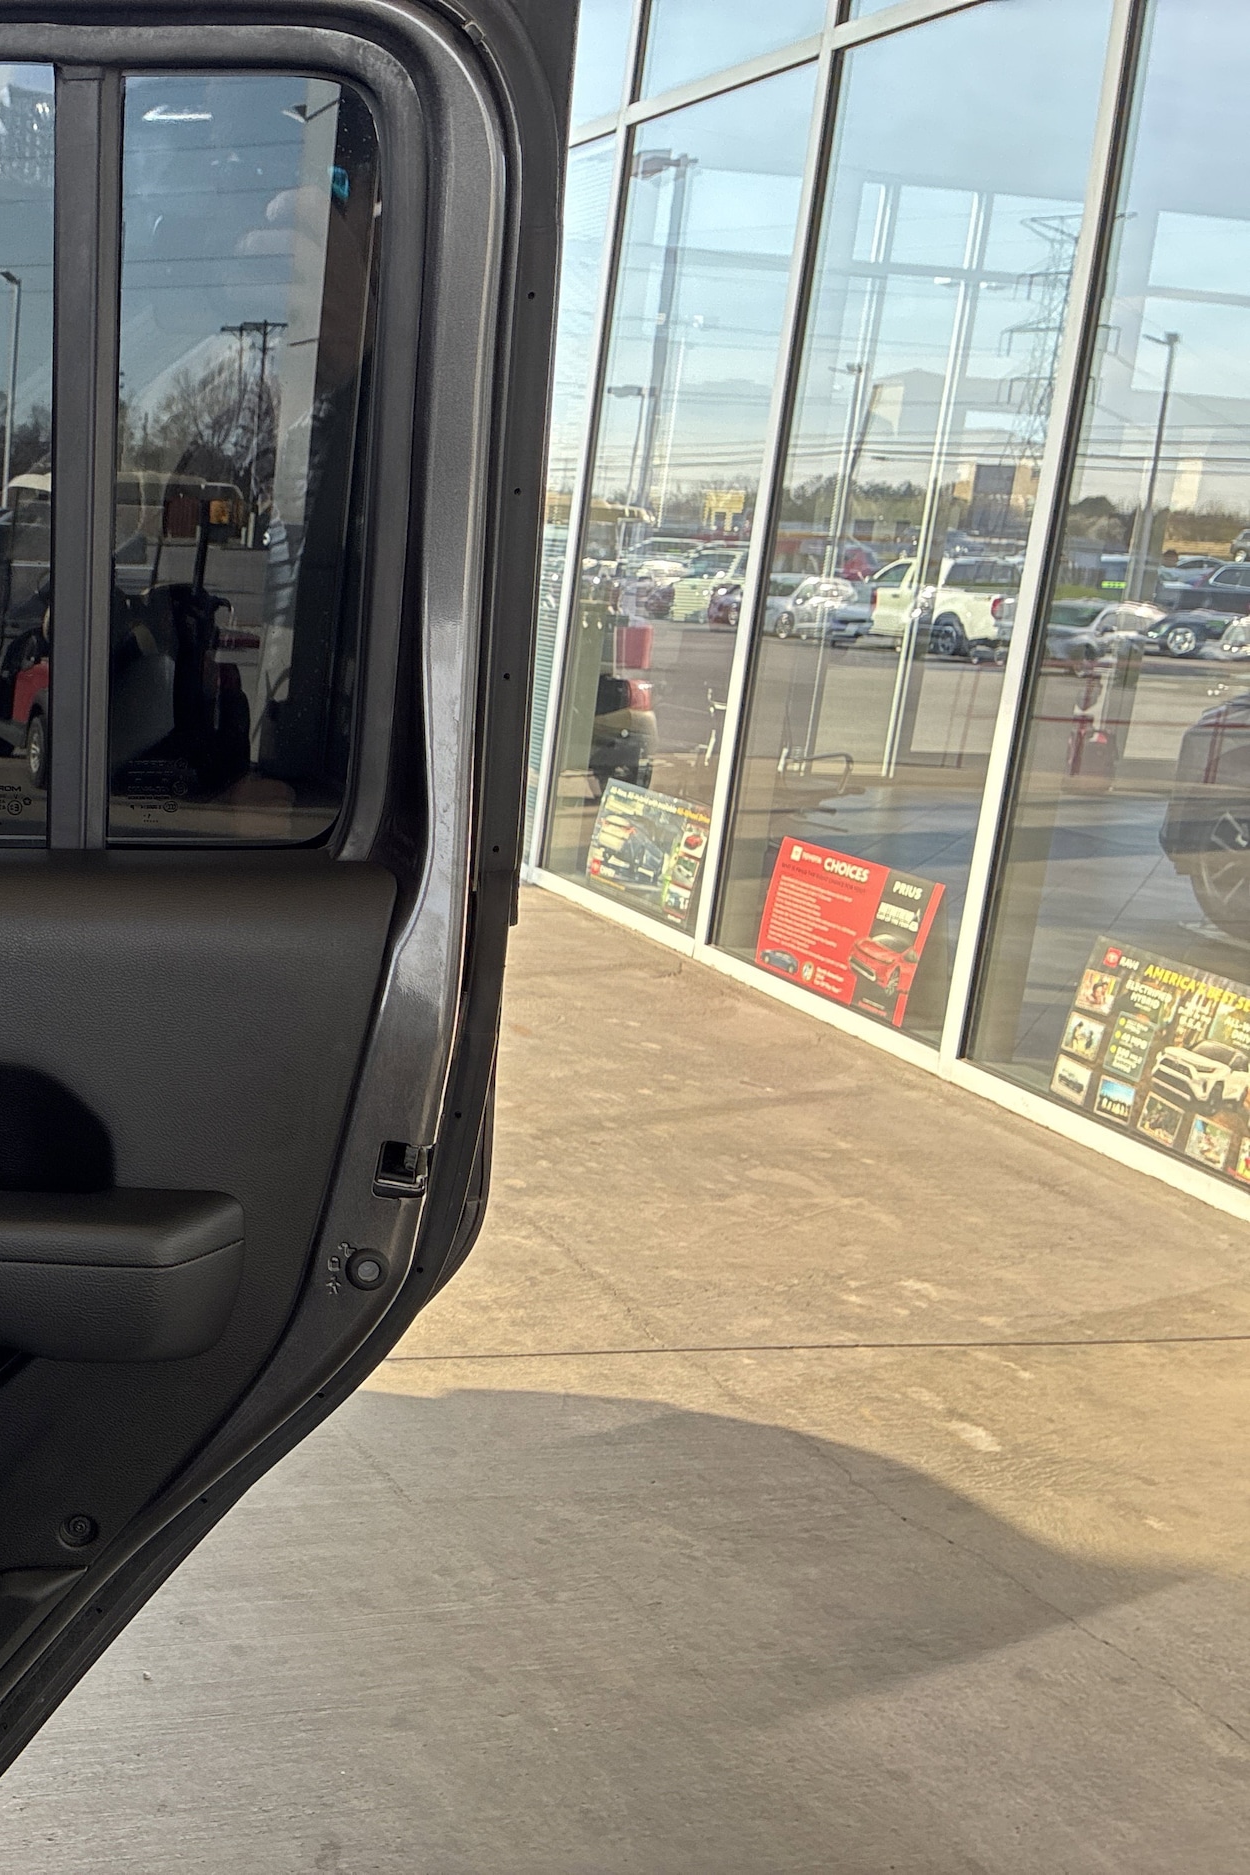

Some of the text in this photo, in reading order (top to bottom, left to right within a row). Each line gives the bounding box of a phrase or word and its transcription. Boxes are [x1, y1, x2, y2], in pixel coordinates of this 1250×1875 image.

[823, 857, 870, 883] CHOICES
[892, 880, 923, 900] PRIUS
[1144, 964, 1206, 995] AMERICA'S
[1205, 985, 1238, 1006] BEST
